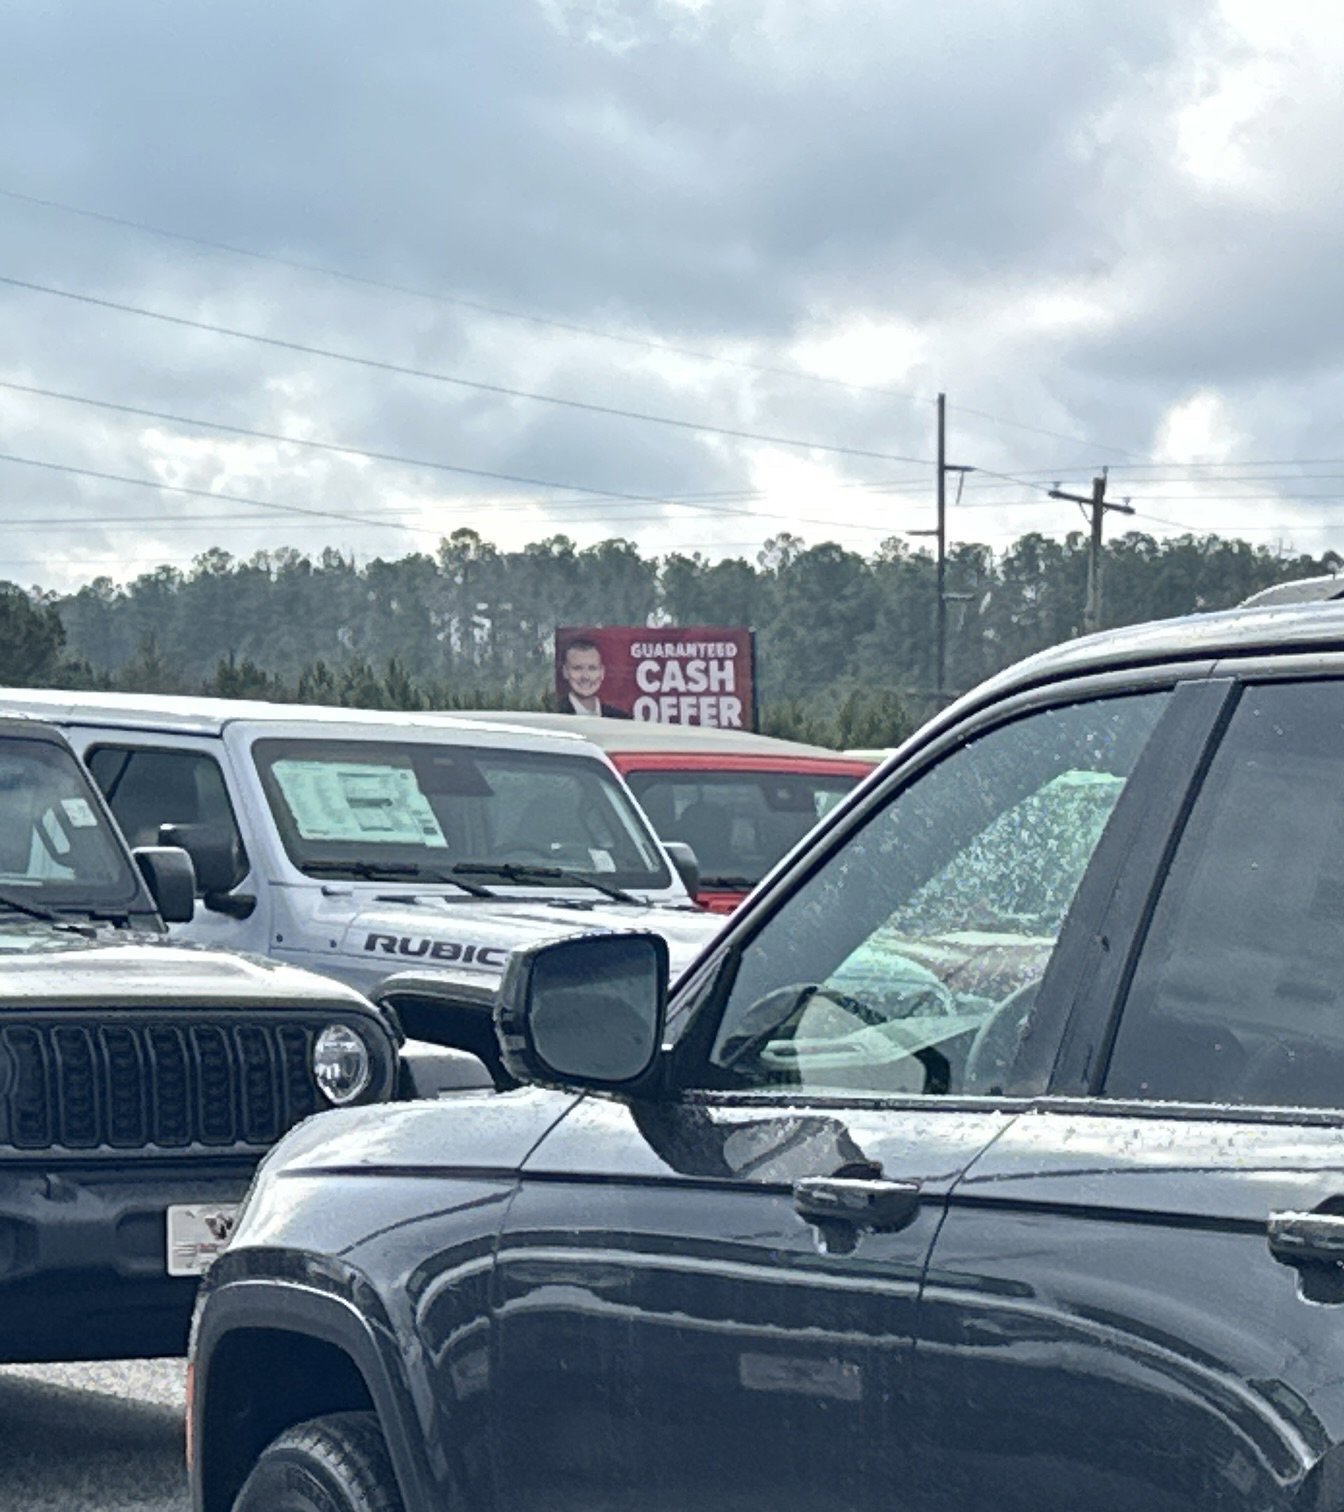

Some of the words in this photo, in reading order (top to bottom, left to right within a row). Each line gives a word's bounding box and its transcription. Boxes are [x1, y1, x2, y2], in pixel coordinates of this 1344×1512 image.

[630, 642, 738, 658] GUARANTEED
[636, 659, 736, 693] CASH
[632, 695, 743, 727] OFFER
[364, 933, 508, 967] RUBIC
